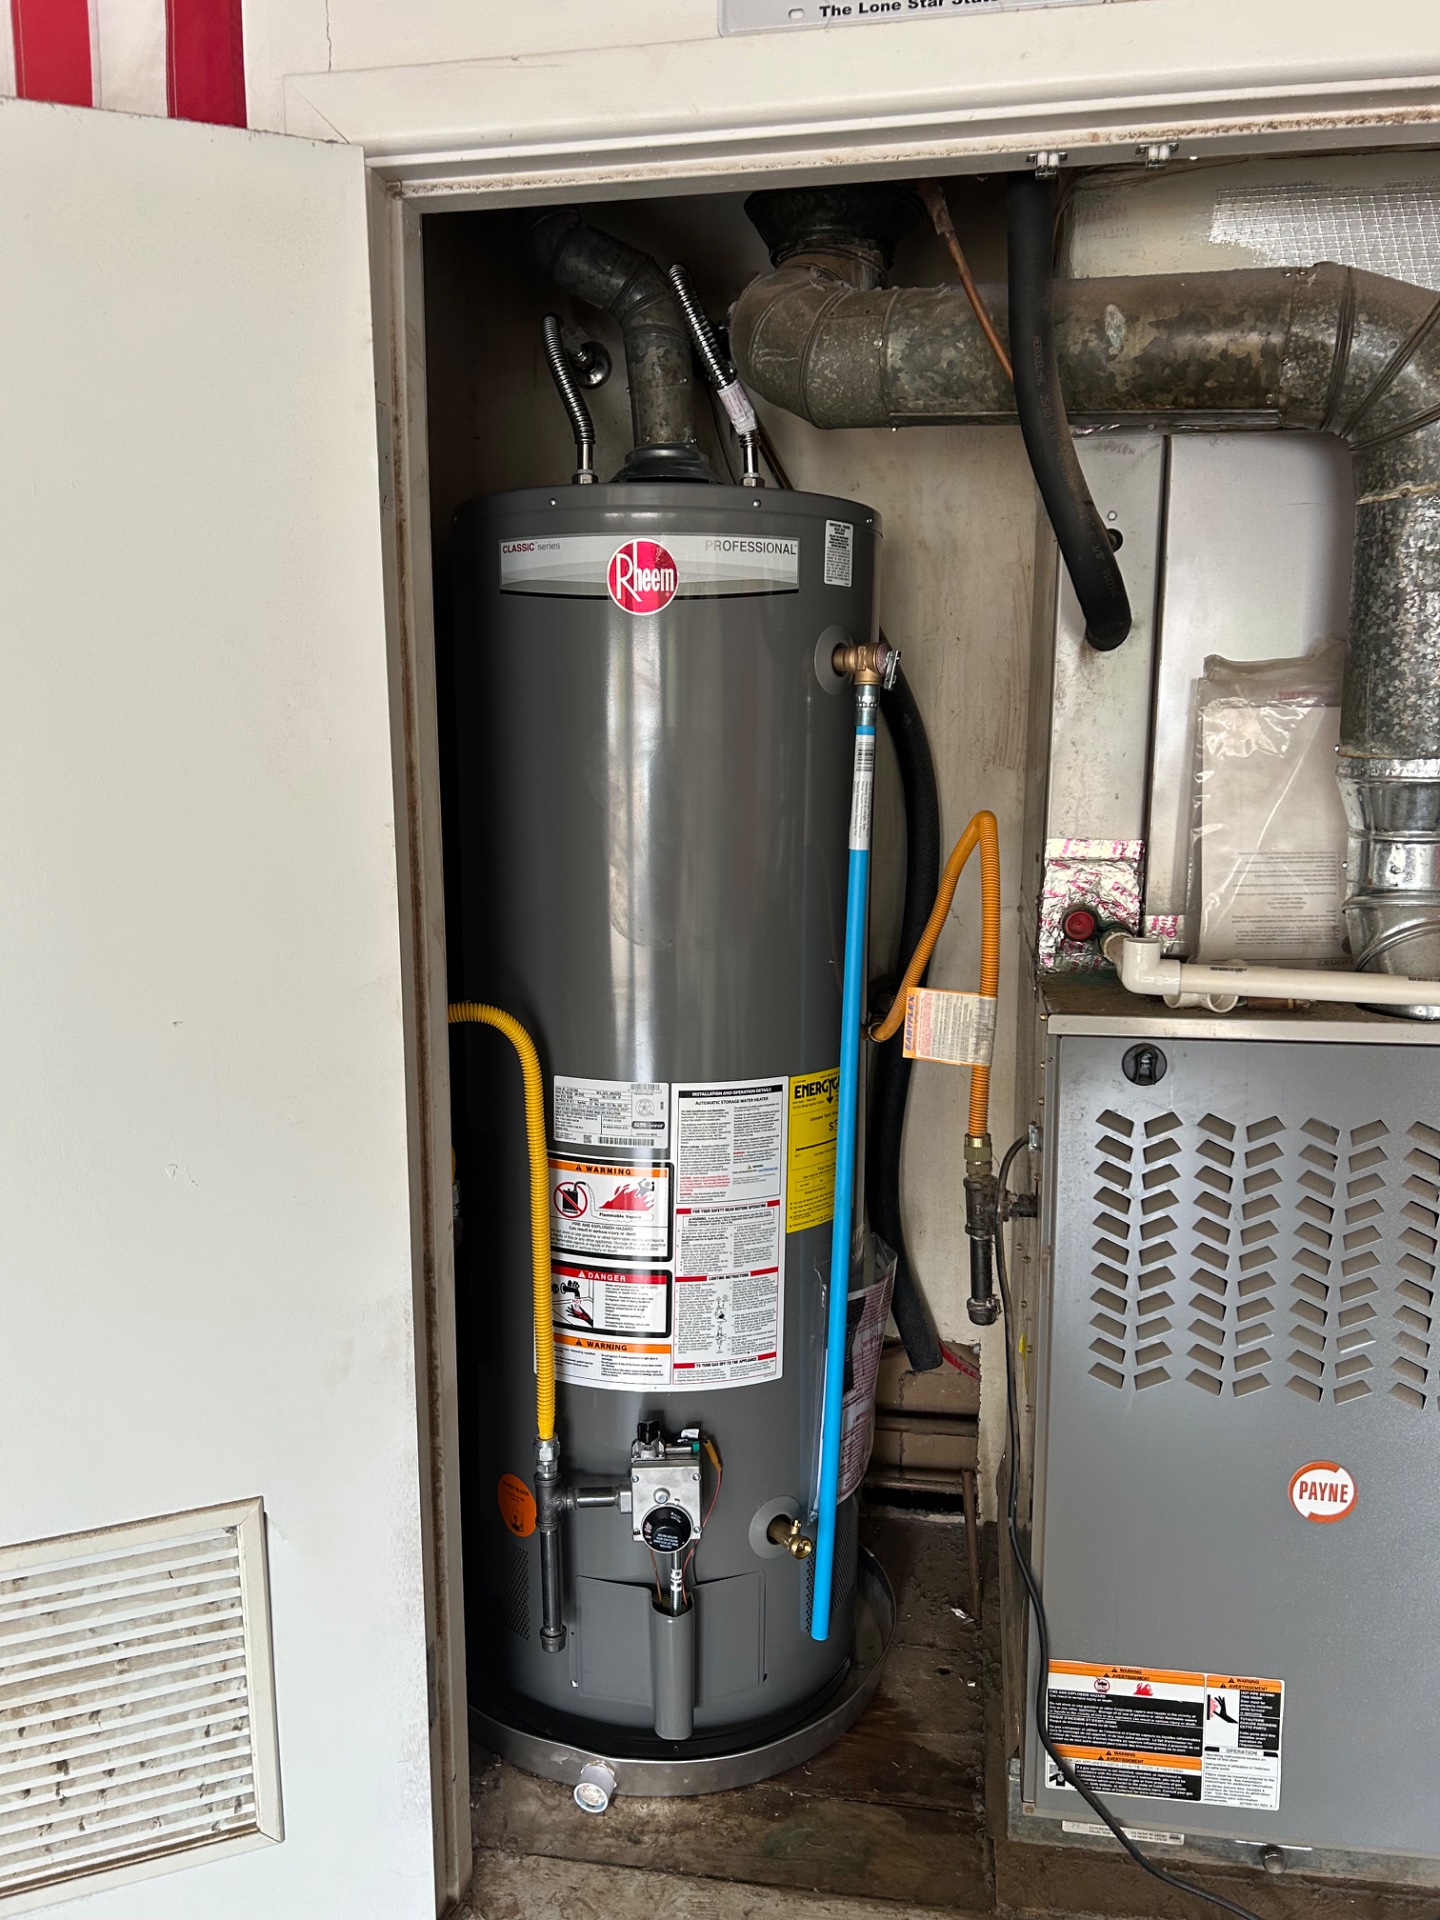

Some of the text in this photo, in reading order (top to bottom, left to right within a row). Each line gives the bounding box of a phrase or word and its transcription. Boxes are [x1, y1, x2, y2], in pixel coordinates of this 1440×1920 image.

[819, 5, 851, 17] The
[858, 1, 901, 14] Lone
[908, 0, 944, 8] Star
[538, 542, 560, 551] series
[706, 540, 796, 555] PROFESSIONAL
[616, 541, 674, 602] Rheem
[905, 994, 916, 1051] EASYFLEX
[586, 1166, 632, 1175] WARNING
[588, 1272, 626, 1282] DANGER
[586, 1340, 627, 1351] WARNING
[1299, 1480, 1348, 1503] PAYNE
